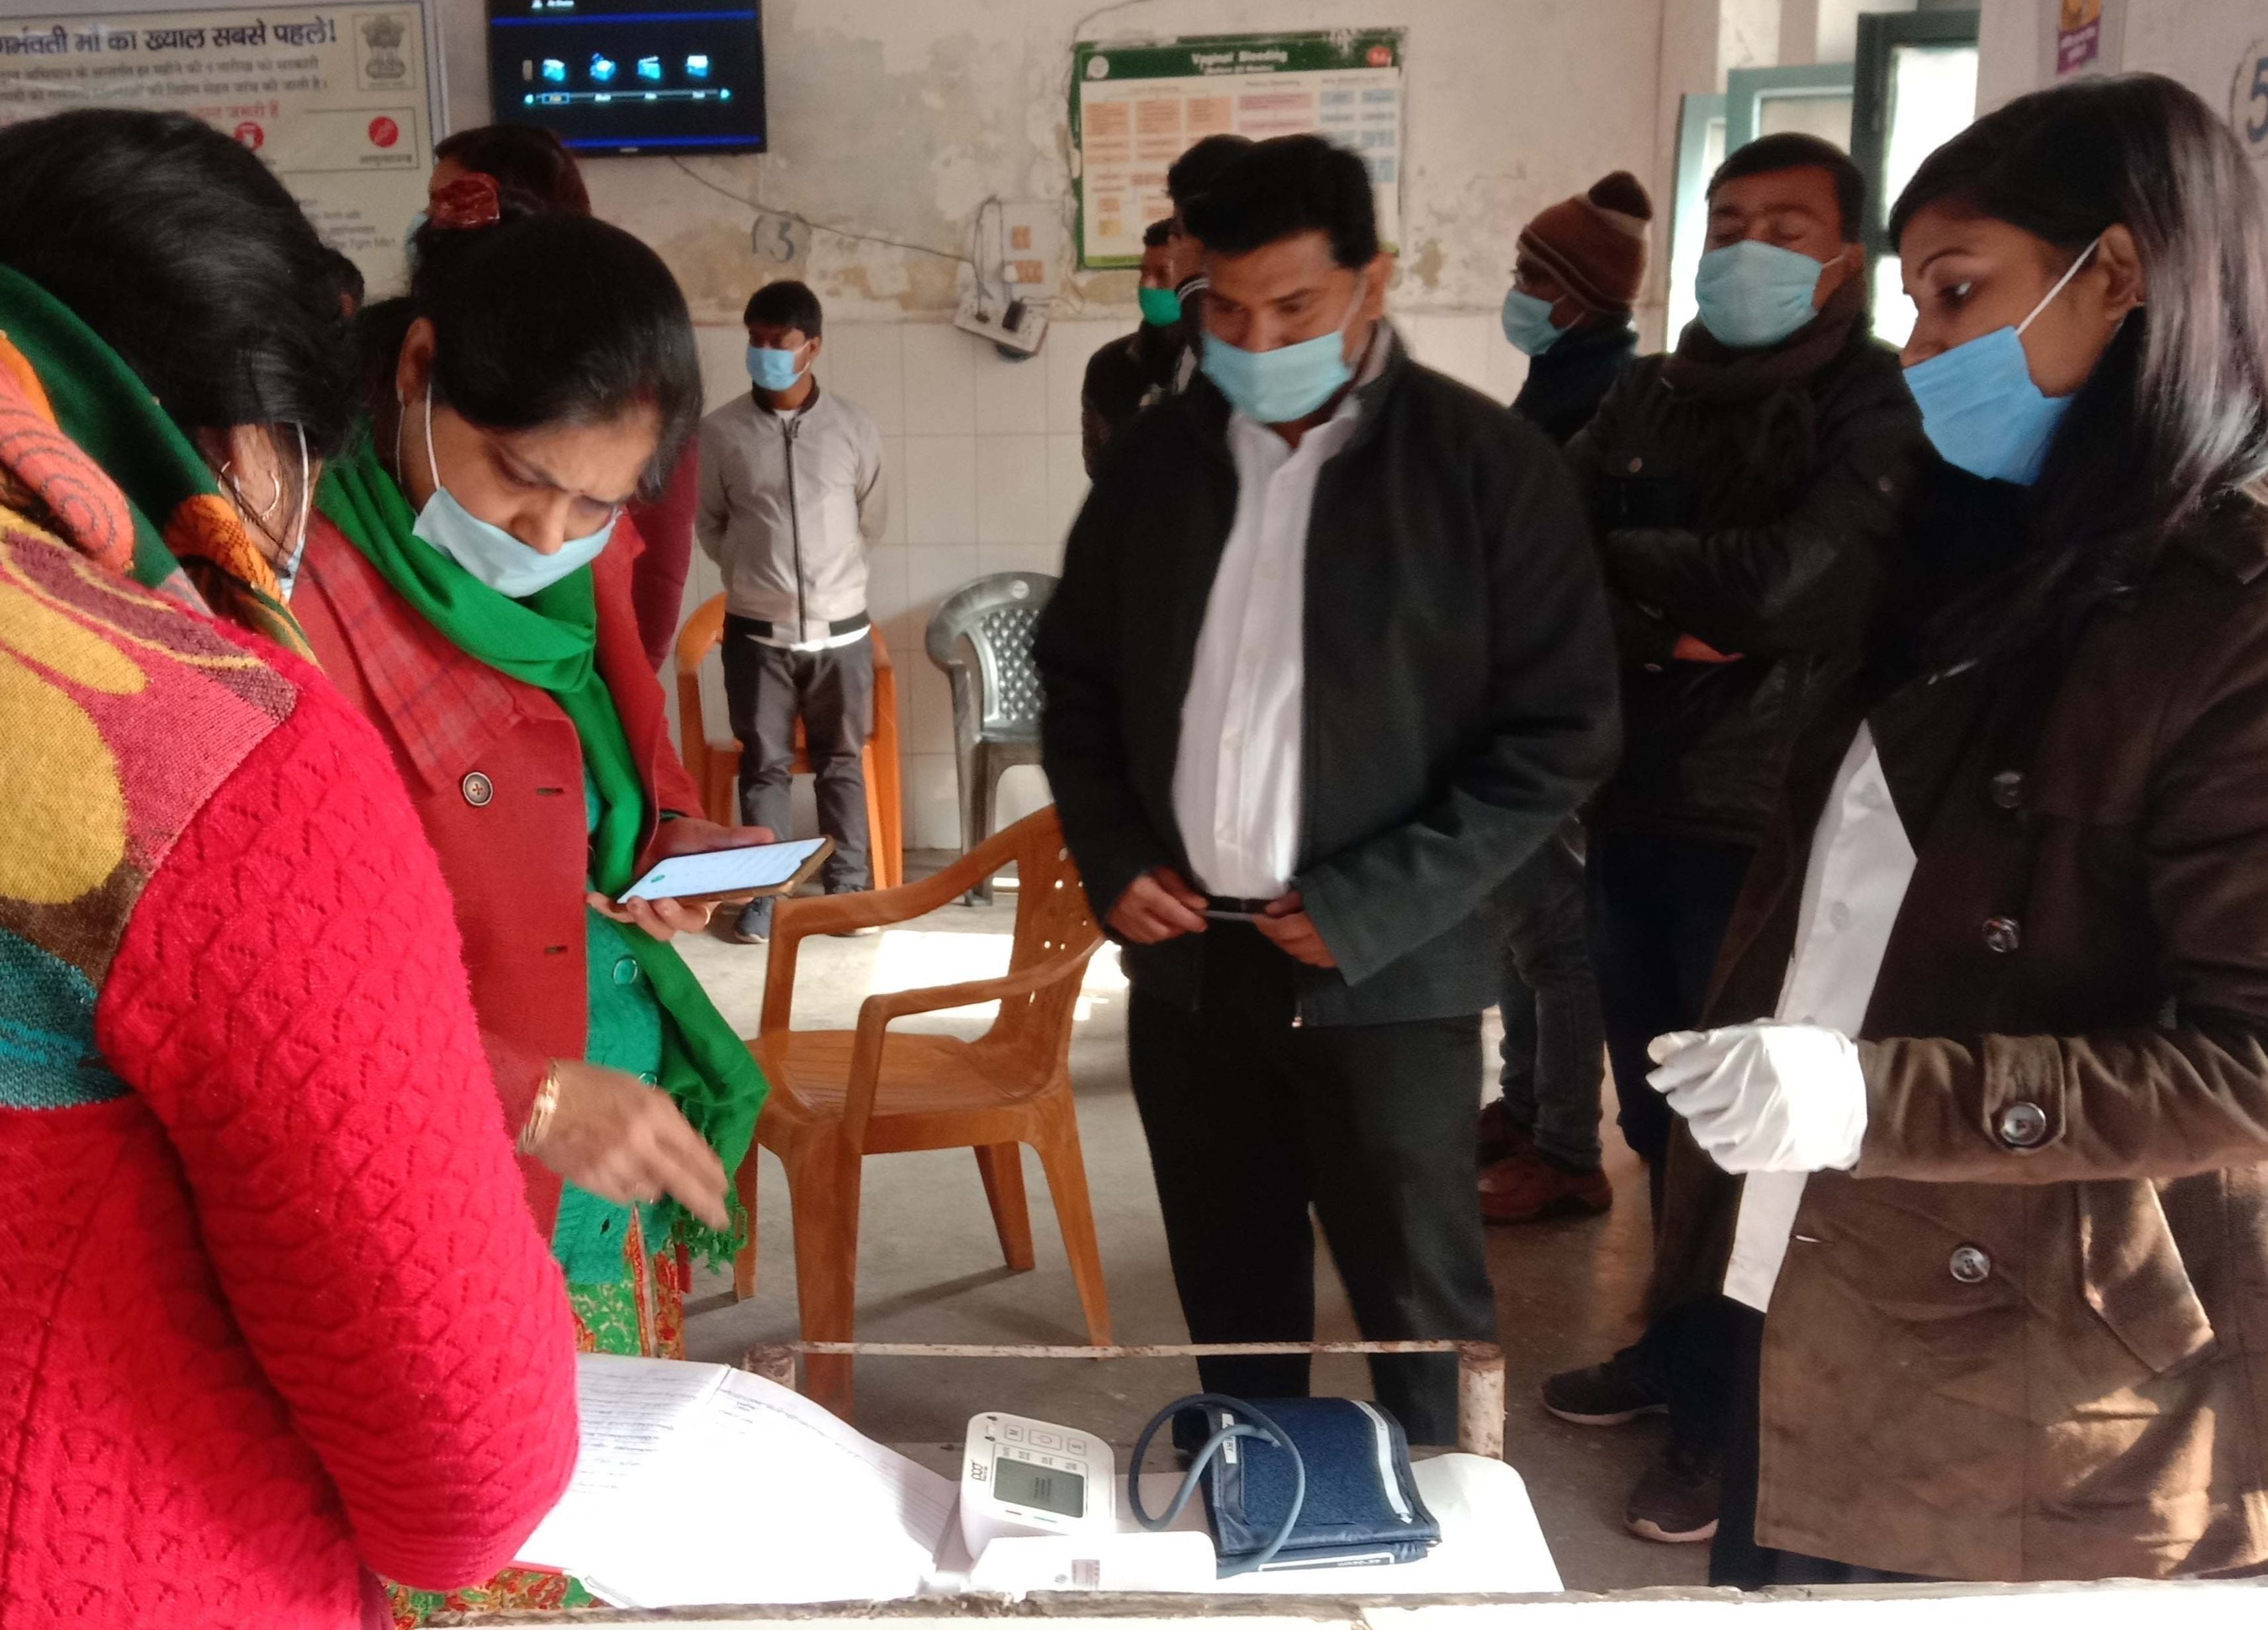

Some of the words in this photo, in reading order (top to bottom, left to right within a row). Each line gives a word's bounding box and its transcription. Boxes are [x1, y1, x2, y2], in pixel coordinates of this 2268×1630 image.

[108, 30, 138, 51] का
[143, 28, 206, 50] ख्याल
[211, 19, 266, 47] सबसे
[273, 15, 336, 46] पहले!
